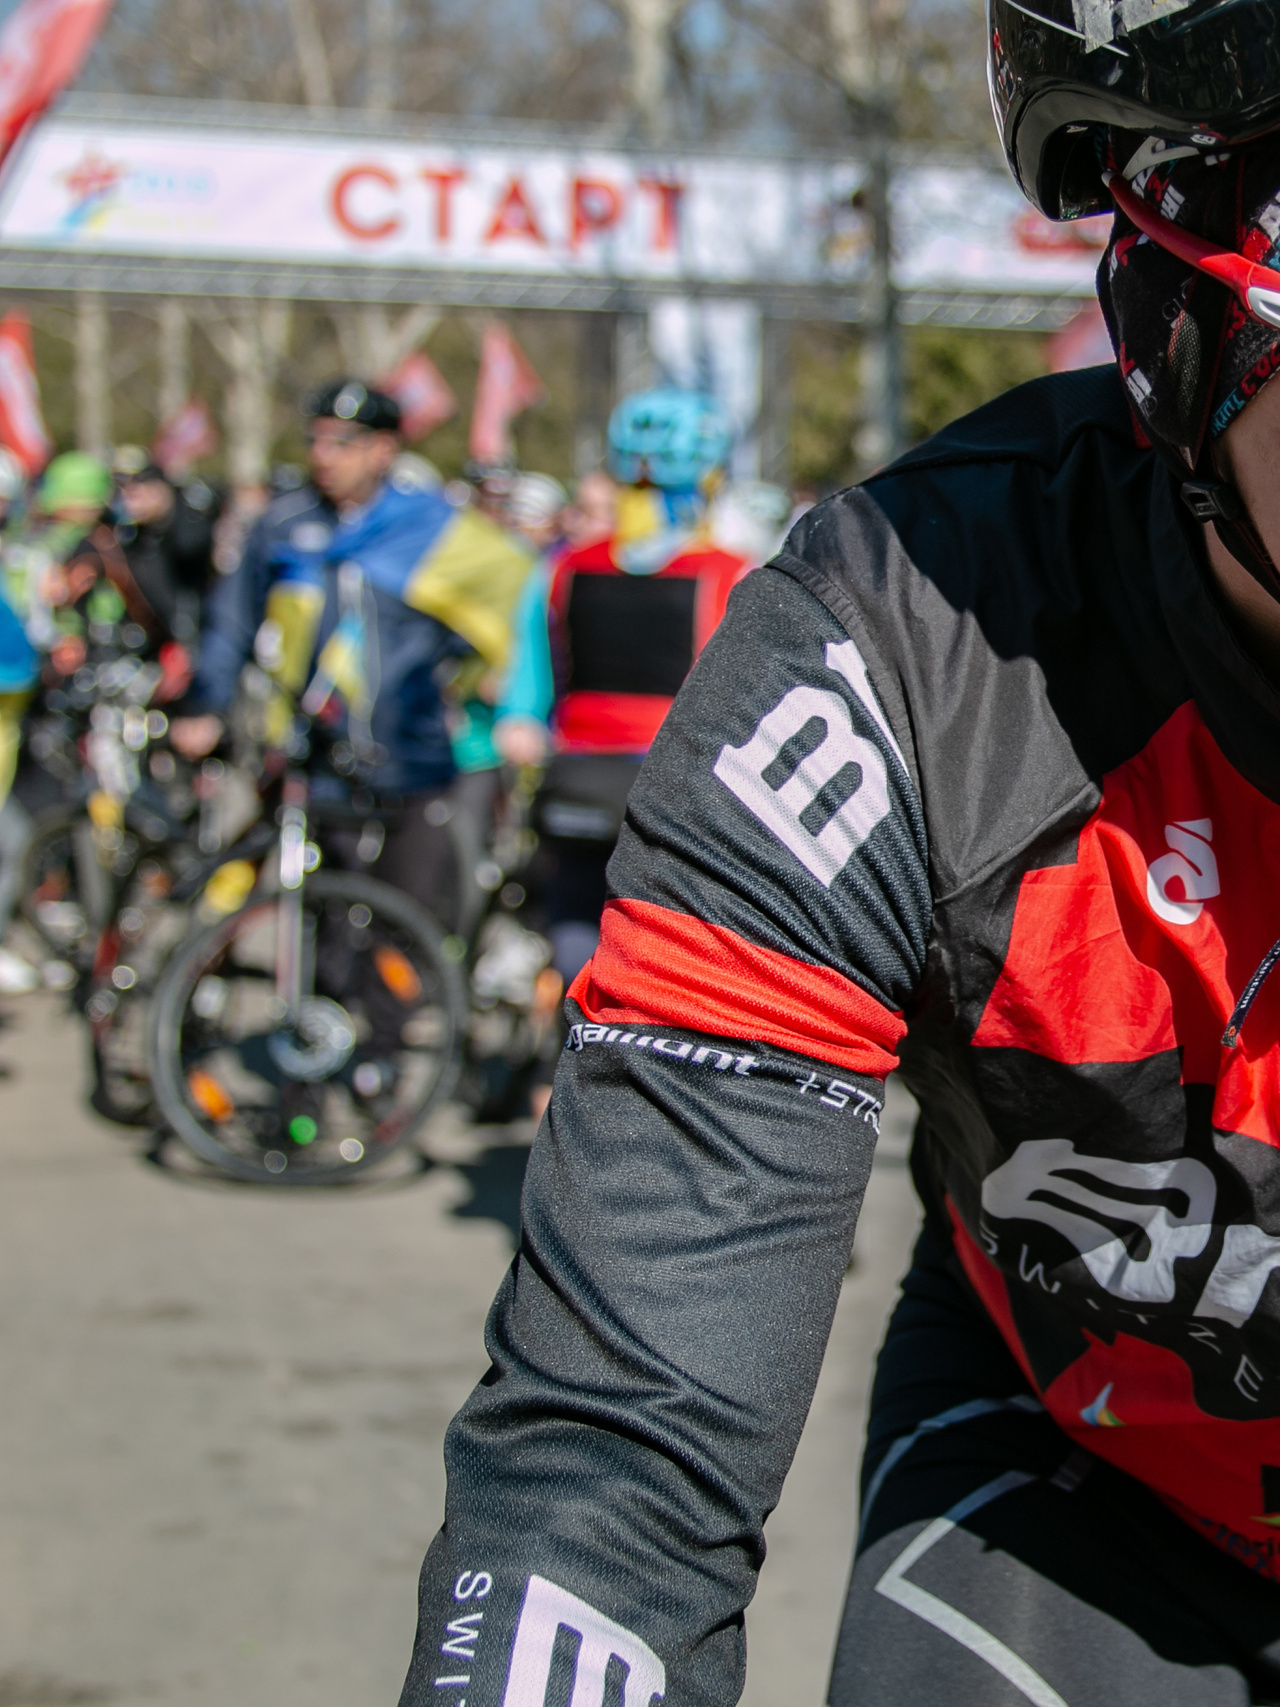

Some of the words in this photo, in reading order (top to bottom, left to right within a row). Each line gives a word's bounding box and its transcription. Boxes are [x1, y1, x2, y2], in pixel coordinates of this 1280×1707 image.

[329, 162, 689, 252] СТАРТ
[567, 1022, 760, 1077] gamont
[434, 1569, 492, 1707] SWI
